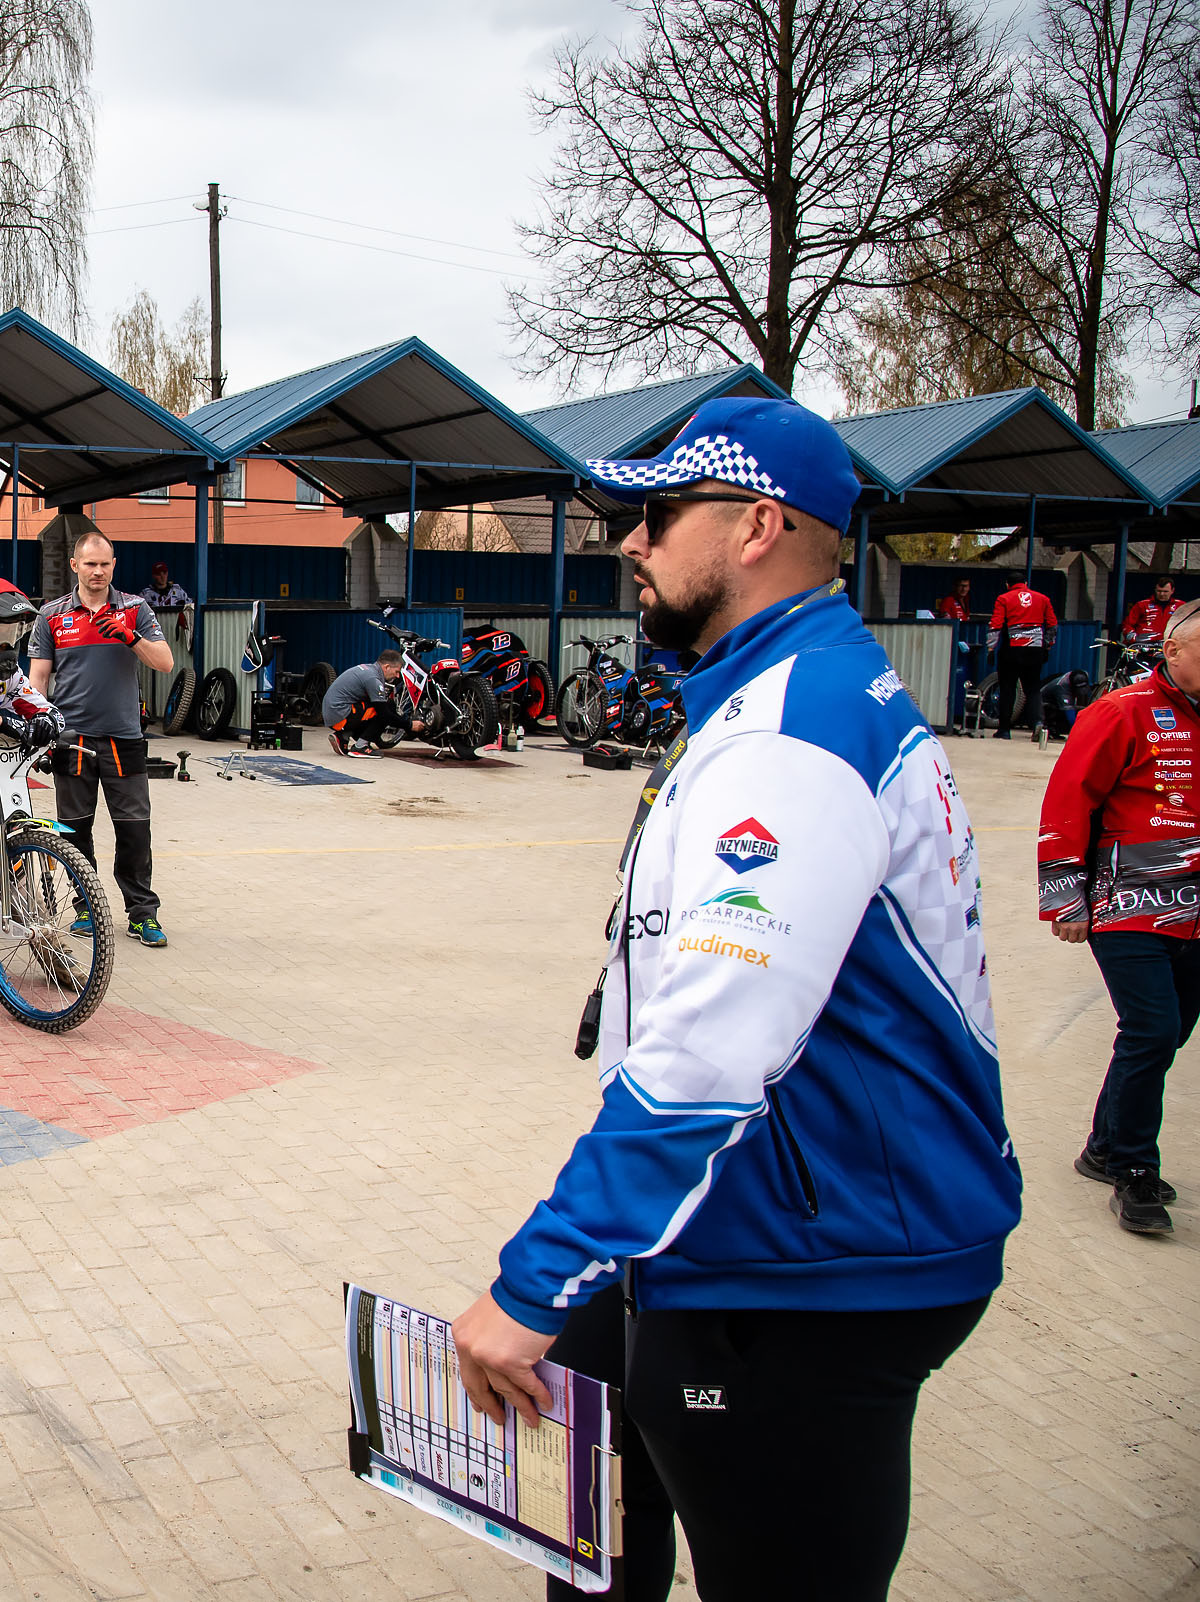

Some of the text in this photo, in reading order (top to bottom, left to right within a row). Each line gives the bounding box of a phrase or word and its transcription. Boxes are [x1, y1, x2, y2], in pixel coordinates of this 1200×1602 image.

[492, 633, 511, 651] 12
[505, 661, 521, 682] 12
[1160, 731, 1191, 739] OPTIBET
[663, 739, 686, 771] pzm.pl
[1162, 819, 1195, 829] STOKKER
[680, 906, 793, 935] POKARPACKIE
[383, 1302, 391, 1312] 15
[400, 1309, 408, 1319] 14
[418, 1316, 426, 1326] 13
[435, 1323, 444, 1334] 12
[683, 1388, 722, 1405] EA7
